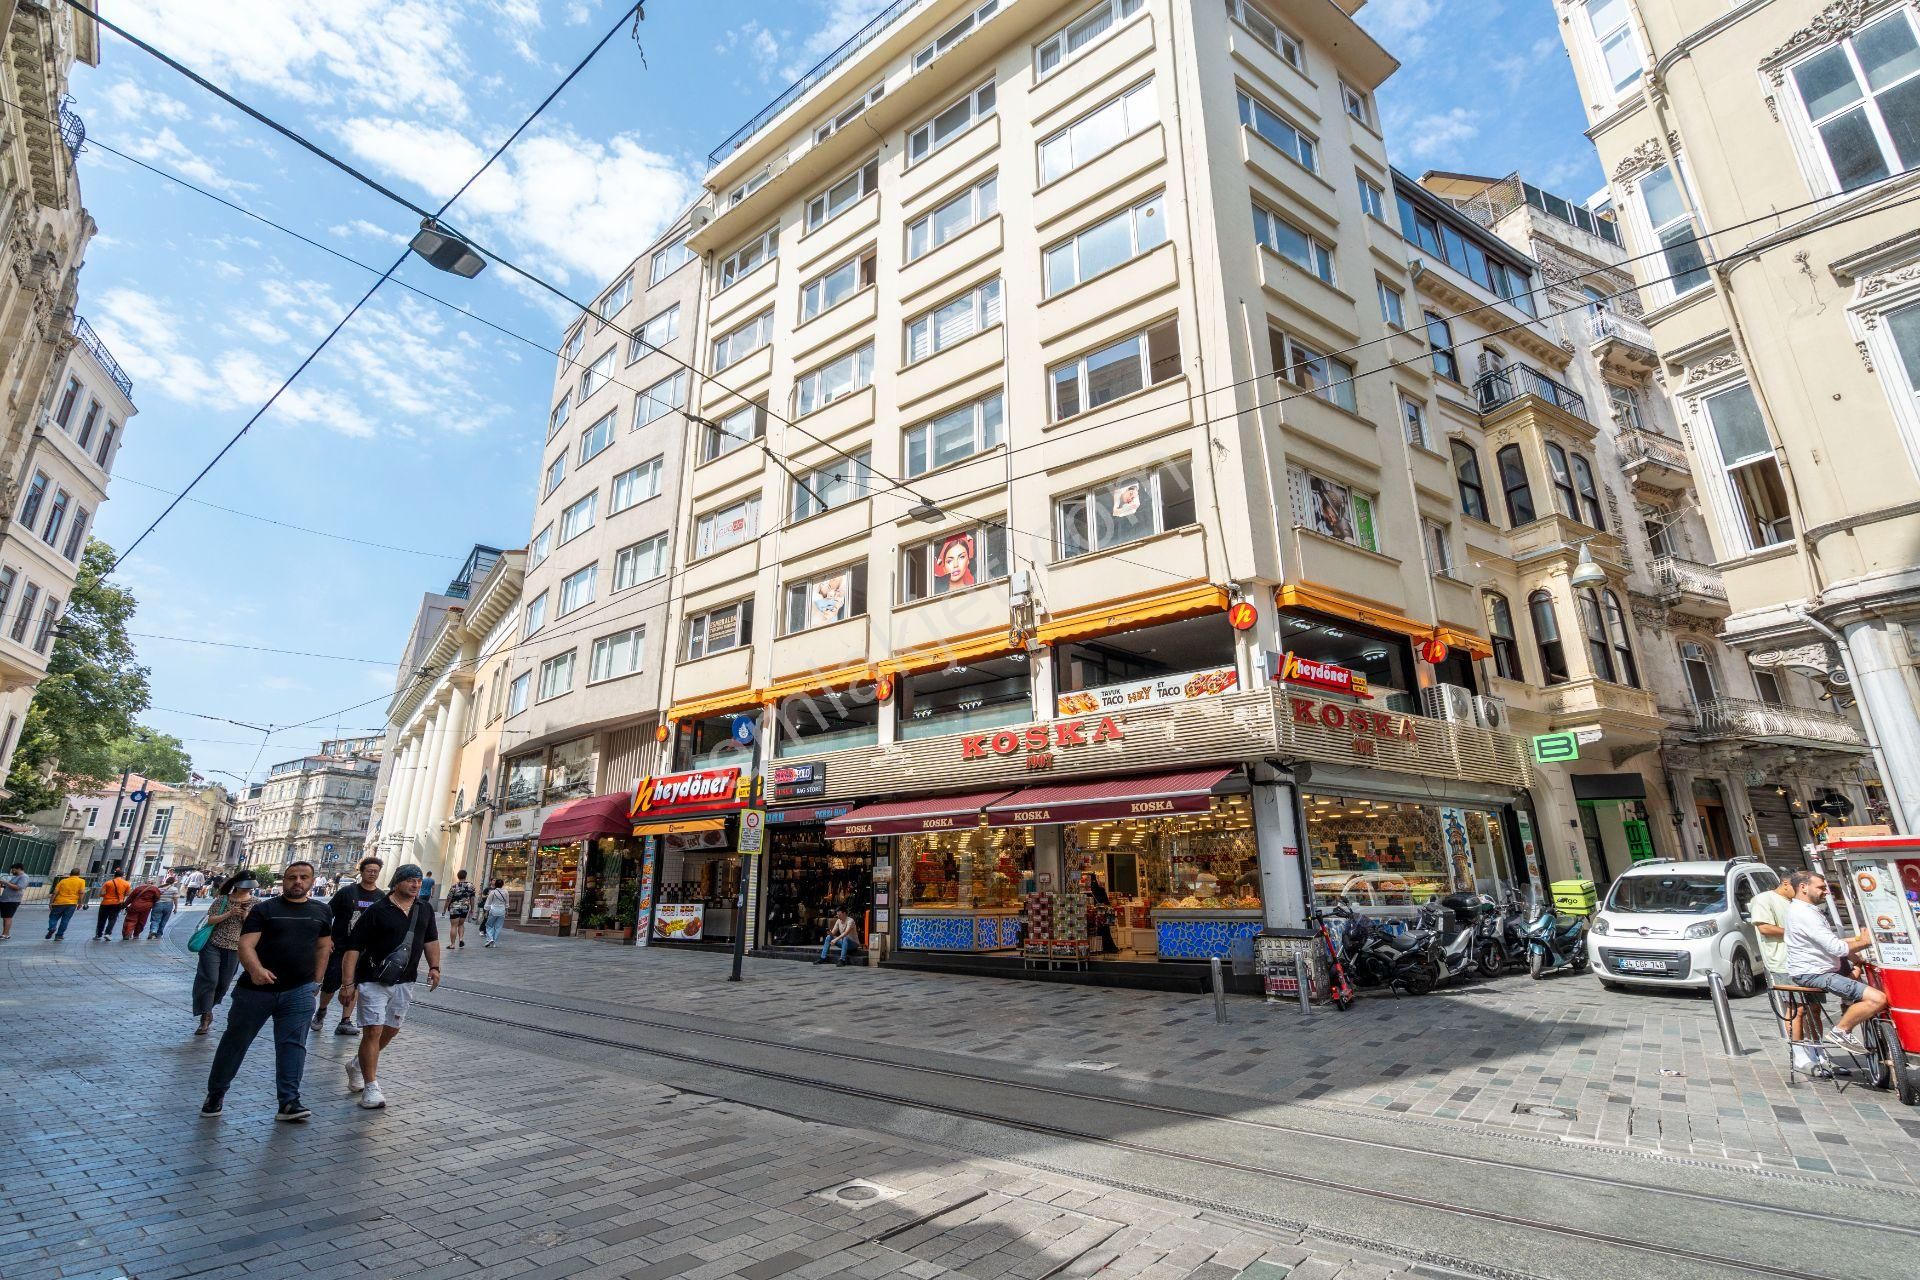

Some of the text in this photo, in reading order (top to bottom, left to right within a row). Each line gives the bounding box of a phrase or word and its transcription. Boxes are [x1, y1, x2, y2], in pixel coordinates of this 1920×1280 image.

[1297, 659, 1348, 684] heydöner
[1101, 688, 1121, 697] TAVUK
[1101, 686, 1181, 707] TACO HEY TACO
[1289, 696, 1418, 743] KOSKA
[961, 715, 1124, 760] KOSKA
[1025, 754, 1053, 769] 1907
[653, 775, 730, 803] heydöner
[806, 785, 822, 793] STORE
[1131, 800, 1175, 813] KOSKA
[923, 817, 954, 828] KOSKA
[1014, 810, 1050, 821] KOSKA
[845, 824, 873, 833] KOSKA
